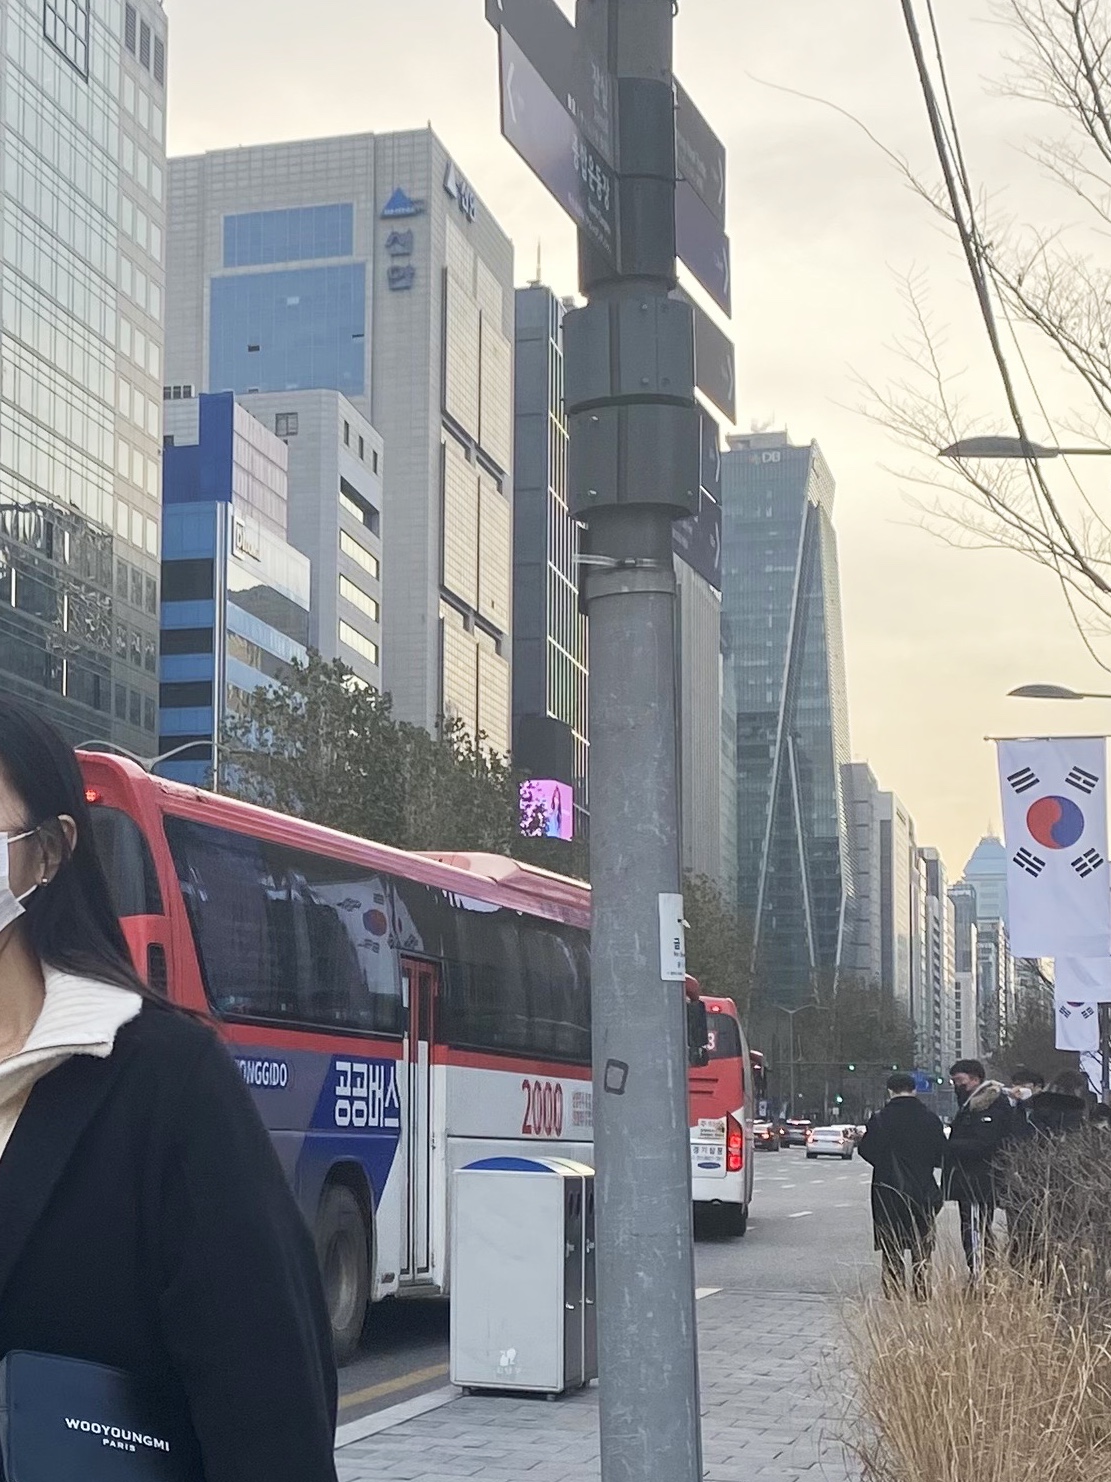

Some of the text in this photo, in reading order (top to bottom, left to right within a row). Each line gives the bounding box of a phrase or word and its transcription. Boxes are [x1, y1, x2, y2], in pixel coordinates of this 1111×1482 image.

[235, 1058, 288, 1088] ONGGIDO
[334, 1060, 400, 1128] 공공버스
[521, 1078, 564, 1138] 2000
[64, 1417, 171, 1452] WOOYOUNGMI
[102, 1438, 137, 1453] PARIS
